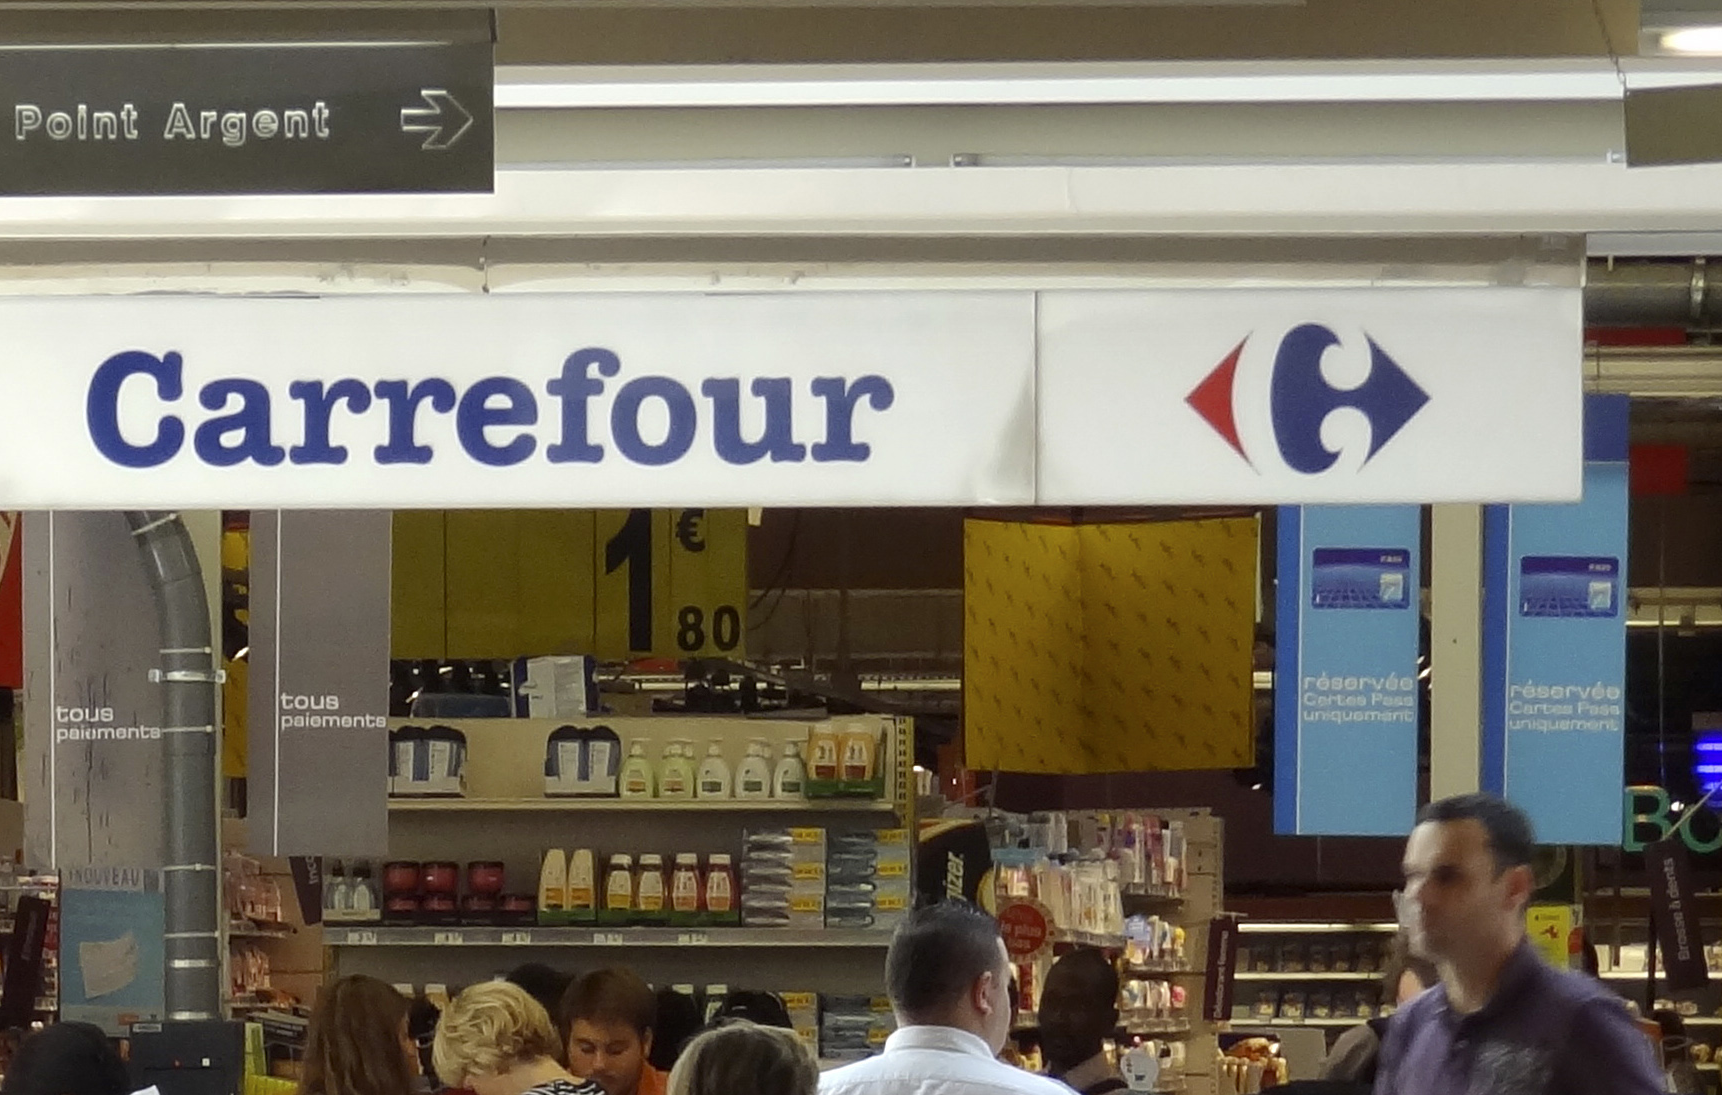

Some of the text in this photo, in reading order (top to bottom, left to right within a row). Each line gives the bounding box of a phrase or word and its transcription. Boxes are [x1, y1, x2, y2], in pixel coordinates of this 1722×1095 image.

[15, 101, 330, 146] Point Argent
[87, 348, 894, 468] Carrefour
[605, 508, 652, 652] 1
[677, 604, 741, 652] 80
[1303, 672, 1414, 691] réservée
[1510, 679, 1620, 699] réservée
[280, 691, 340, 710] tous
[1303, 692, 1414, 707] Cartes Pass
[1509, 701, 1620, 715] Cartes Pass
[56, 705, 114, 722] tous
[281, 711, 387, 731] paiements
[1303, 709, 1415, 725] uniquement
[56, 725, 161, 744] paiements
[1508, 718, 1619, 734] uniquement
[1663, 857, 1680, 899] dents
[1673, 911, 1691, 961] Brosse
